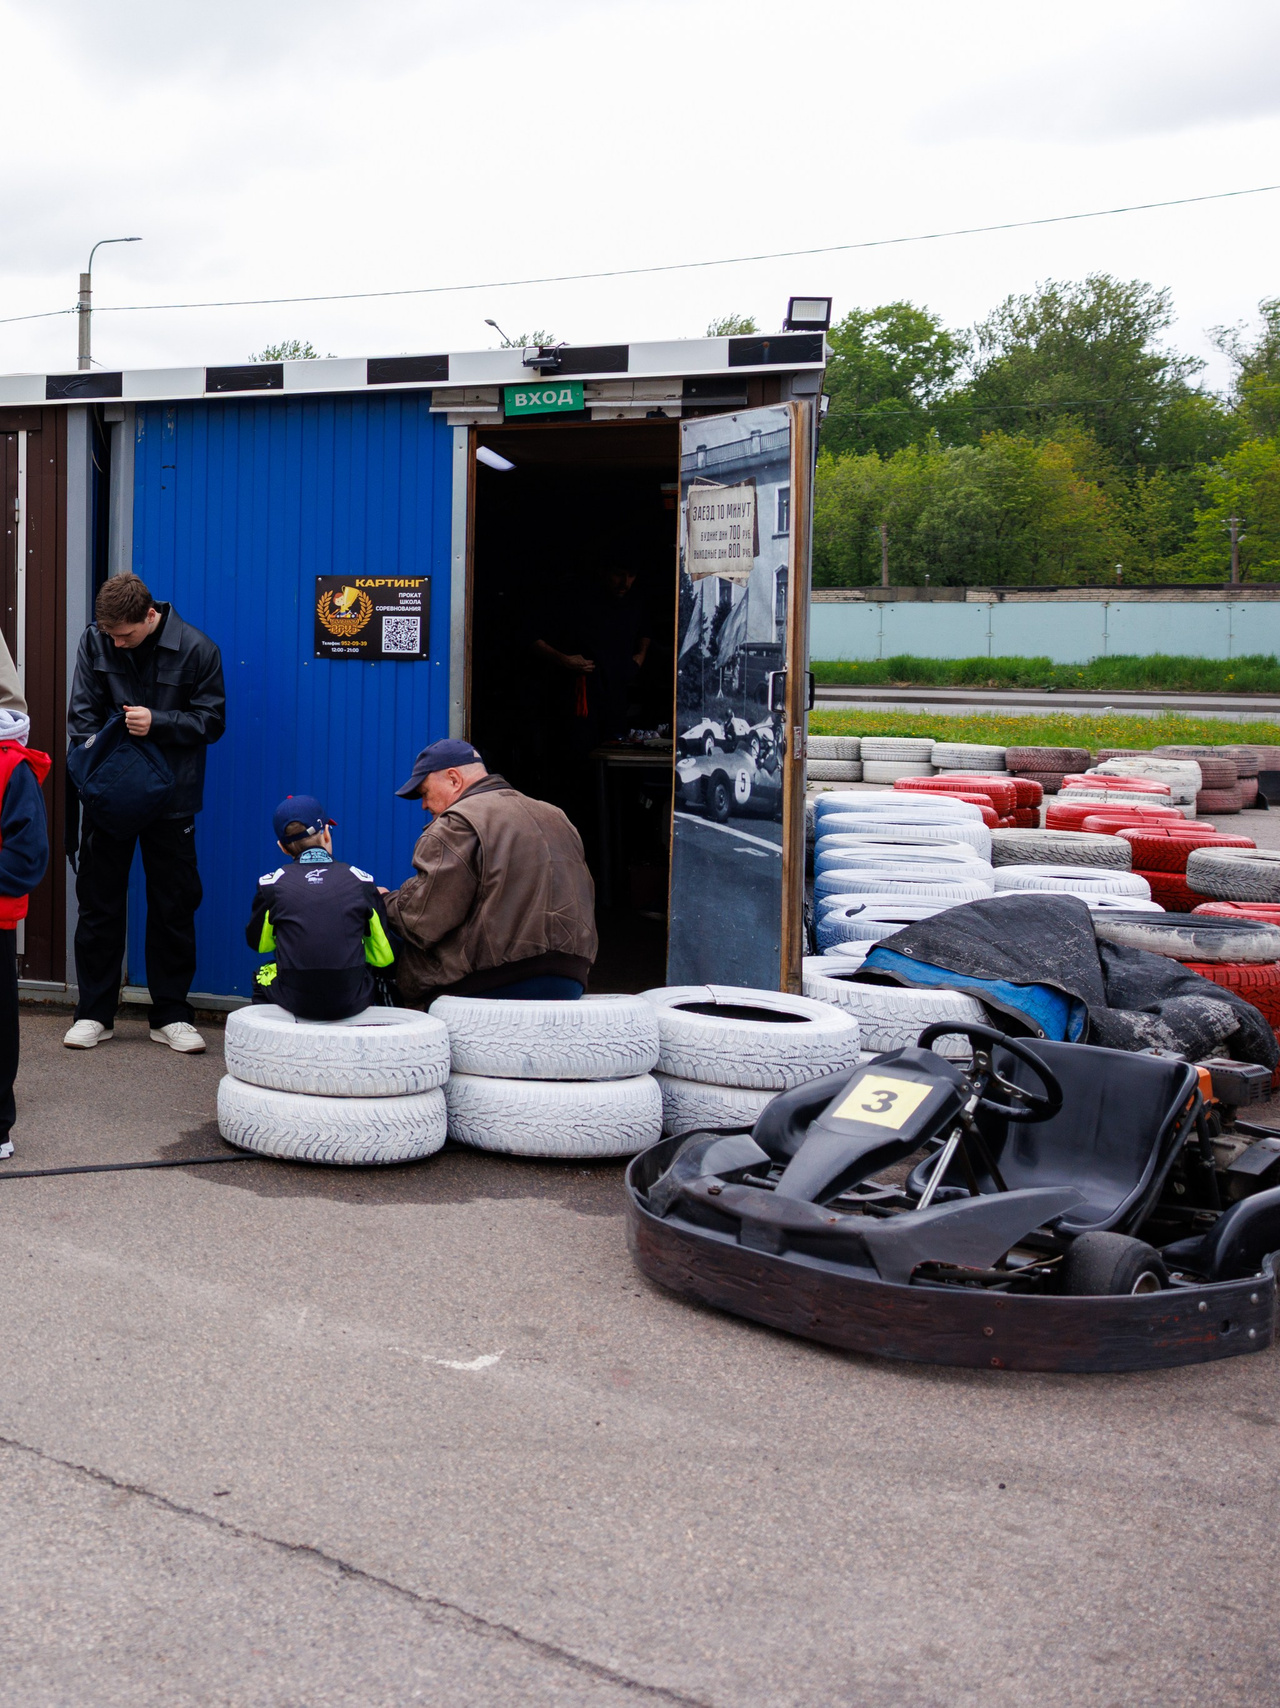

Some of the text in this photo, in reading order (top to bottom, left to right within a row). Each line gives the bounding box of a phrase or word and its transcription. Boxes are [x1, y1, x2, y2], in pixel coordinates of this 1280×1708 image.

[514, 389, 573, 407] ВХОД
[692, 502, 751, 521] ЗАЕЗД 10 МИНУТ
[700, 531, 718, 541] БУДНИЕ
[719, 531, 727, 540] ДНИ
[729, 525, 740, 540] 700
[718, 549, 727, 559] ДНИ
[728, 543, 740, 558] 800
[355, 579, 424, 587] КАРТИНГ
[740, 773, 746, 792] 5
[861, 1090, 898, 1113] 3
